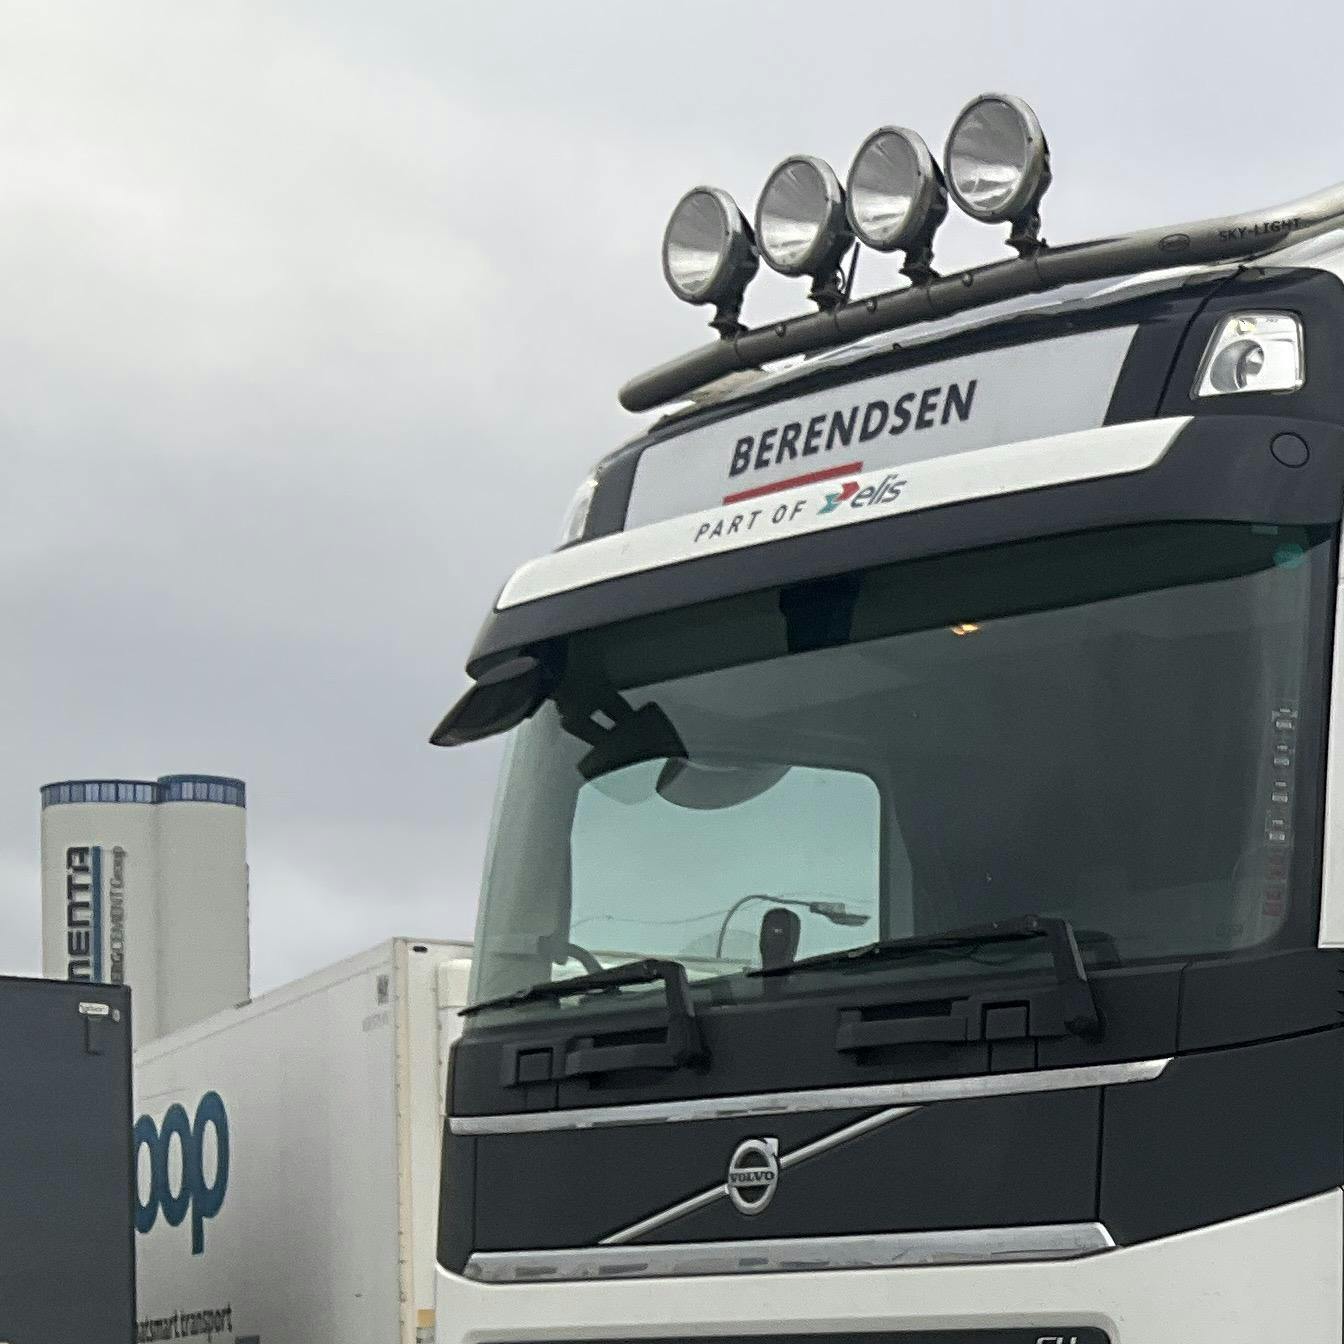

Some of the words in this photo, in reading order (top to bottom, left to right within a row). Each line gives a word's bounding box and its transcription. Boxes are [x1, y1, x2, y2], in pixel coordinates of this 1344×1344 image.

[1218, 217, 1301, 242] SKY-LIGHT
[728, 379, 978, 478] BERENDSEN
[694, 509, 762, 542] PART
[771, 500, 807, 525] OF
[850, 474, 907, 508] elis
